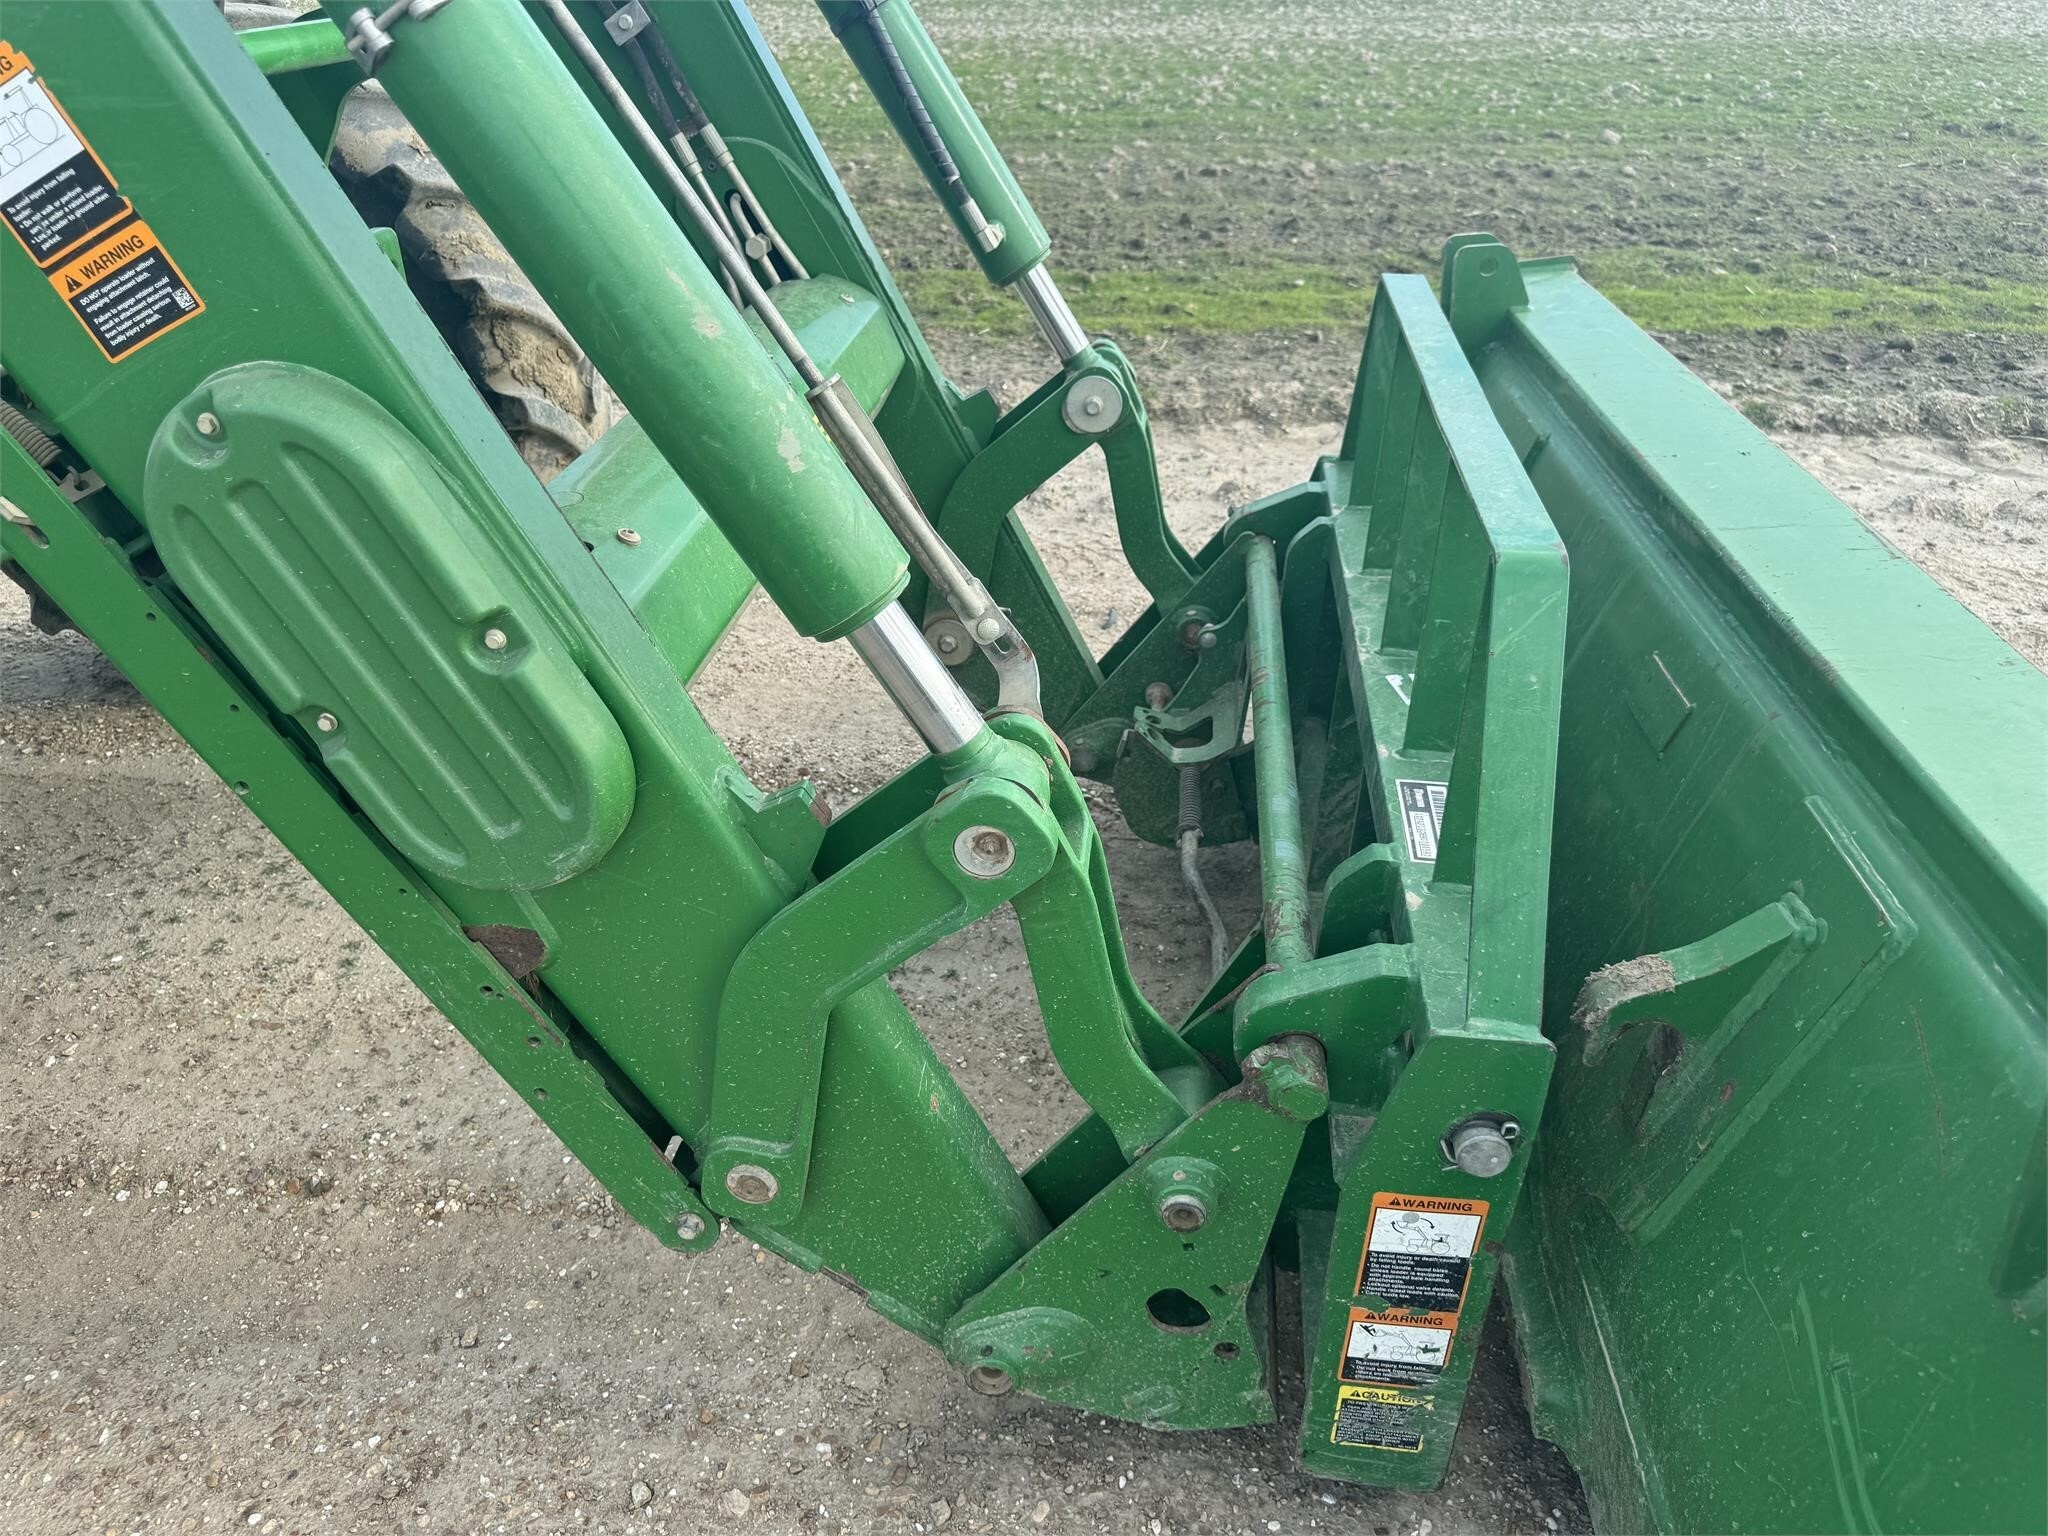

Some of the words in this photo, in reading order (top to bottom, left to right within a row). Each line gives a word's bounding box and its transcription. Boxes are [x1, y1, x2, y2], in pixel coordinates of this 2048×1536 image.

[27, 187, 46, 201] injury
[43, 179, 59, 191] from
[22, 219, 33, 228] Do
[31, 212, 43, 222] not
[40, 204, 55, 216] walk
[53, 200, 61, 208] or
[48, 209, 65, 223] under
[50, 218, 69, 232] loader
[93, 192, 110, 205] when
[79, 234, 145, 280] WARNING
[79, 296, 90, 306] DO
[88, 289, 101, 301] NOT
[100, 279, 121, 294] operate
[118, 269, 136, 282] loader
[134, 257, 156, 272] without
[86, 296, 110, 313] engaging
[108, 279, 137, 300] attachment
[93, 311, 112, 325] Failure
[116, 297, 136, 311] engage
[134, 285, 155, 300] retainer
[154, 275, 170, 289] could
[99, 319, 116, 332] result
[119, 300, 148, 320] attachment
[146, 286, 173, 304] detaching
[104, 329, 119, 339] from
[116, 319, 133, 332] loader
[132, 308, 154, 323] causing
[151, 297, 172, 311] serious
[109, 334, 127, 346] bodily
[124, 325, 141, 337] injury
[145, 313, 162, 325] death.
[1402, 1198, 1473, 1212] WARNING
[1375, 1312, 1444, 1326] WARNING
